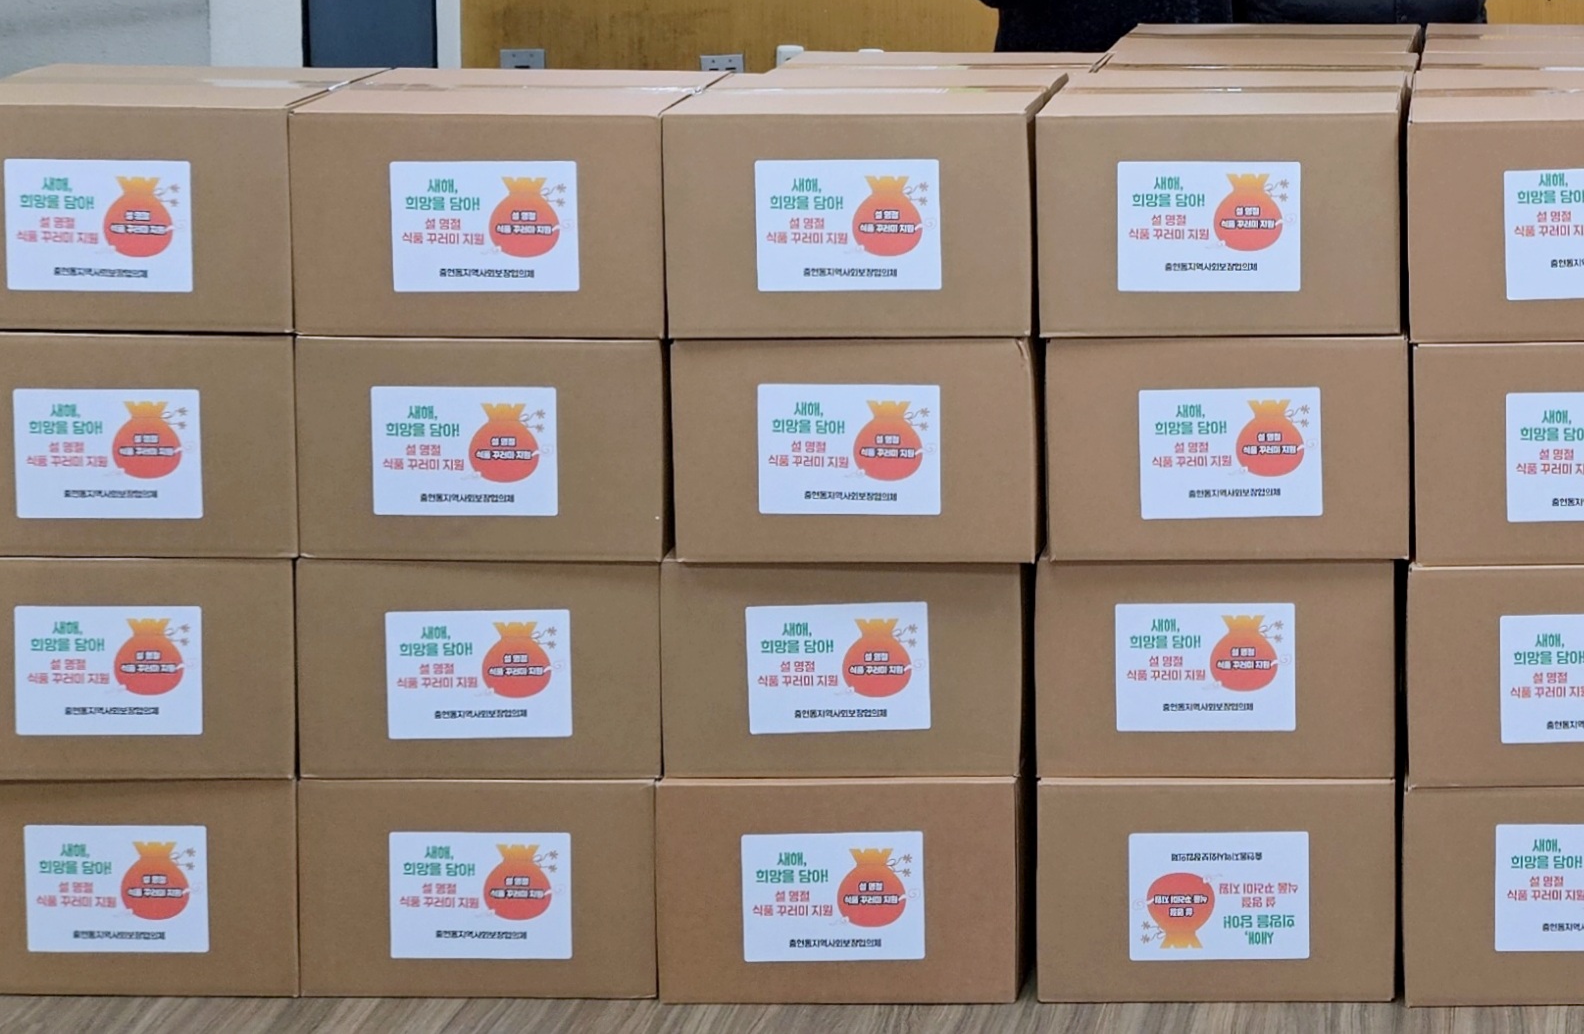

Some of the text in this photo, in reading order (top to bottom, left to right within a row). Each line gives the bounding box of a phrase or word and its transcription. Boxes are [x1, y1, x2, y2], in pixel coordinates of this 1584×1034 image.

[405, 196, 480, 211] 희망을 담아!
[1132, 193, 1205, 208] 희망을 담아!
[425, 218, 461, 230] 설 명절
[1151, 214, 1186, 226] 설 명절
[402, 232, 485, 245] 식품 꾸러미 지원
[1128, 228, 1209, 240] 식품 꾸러미 지원
[385, 423, 460, 437] 희망을 담아!
[1520, 427, 1559, 441] 희망을
[405, 444, 441, 456] 설 명절
[1539, 448, 1573, 460] 설 명절
[382, 459, 465, 471] 식품 꾸러미 지원
[1516, 463, 1537, 474] 식품
[1540, 463, 1572, 474] 꾸러미
[760, 639, 834, 654] 희망을 담아!
[1129, 635, 1201, 649] 희망을 담아!
[780, 660, 815, 673] 설 명절
[1149, 655, 1183, 667] 설 명절
[757, 674, 838, 687] 식품 꾸러미 지원
[1126, 669, 1206, 681] 식품 꾸러미 지원
[1511, 855, 1582, 869] 희망을 담아!
[755, 869, 829, 884] 희망을 담아!
[1529, 876, 1563, 887] 설 명절
[775, 890, 810, 902] 설 명절
[1507, 890, 1528, 901] 식품
[1531, 890, 1562, 901] 꾸러미
[752, 904, 833, 917] 식품 꾸러미 지원
